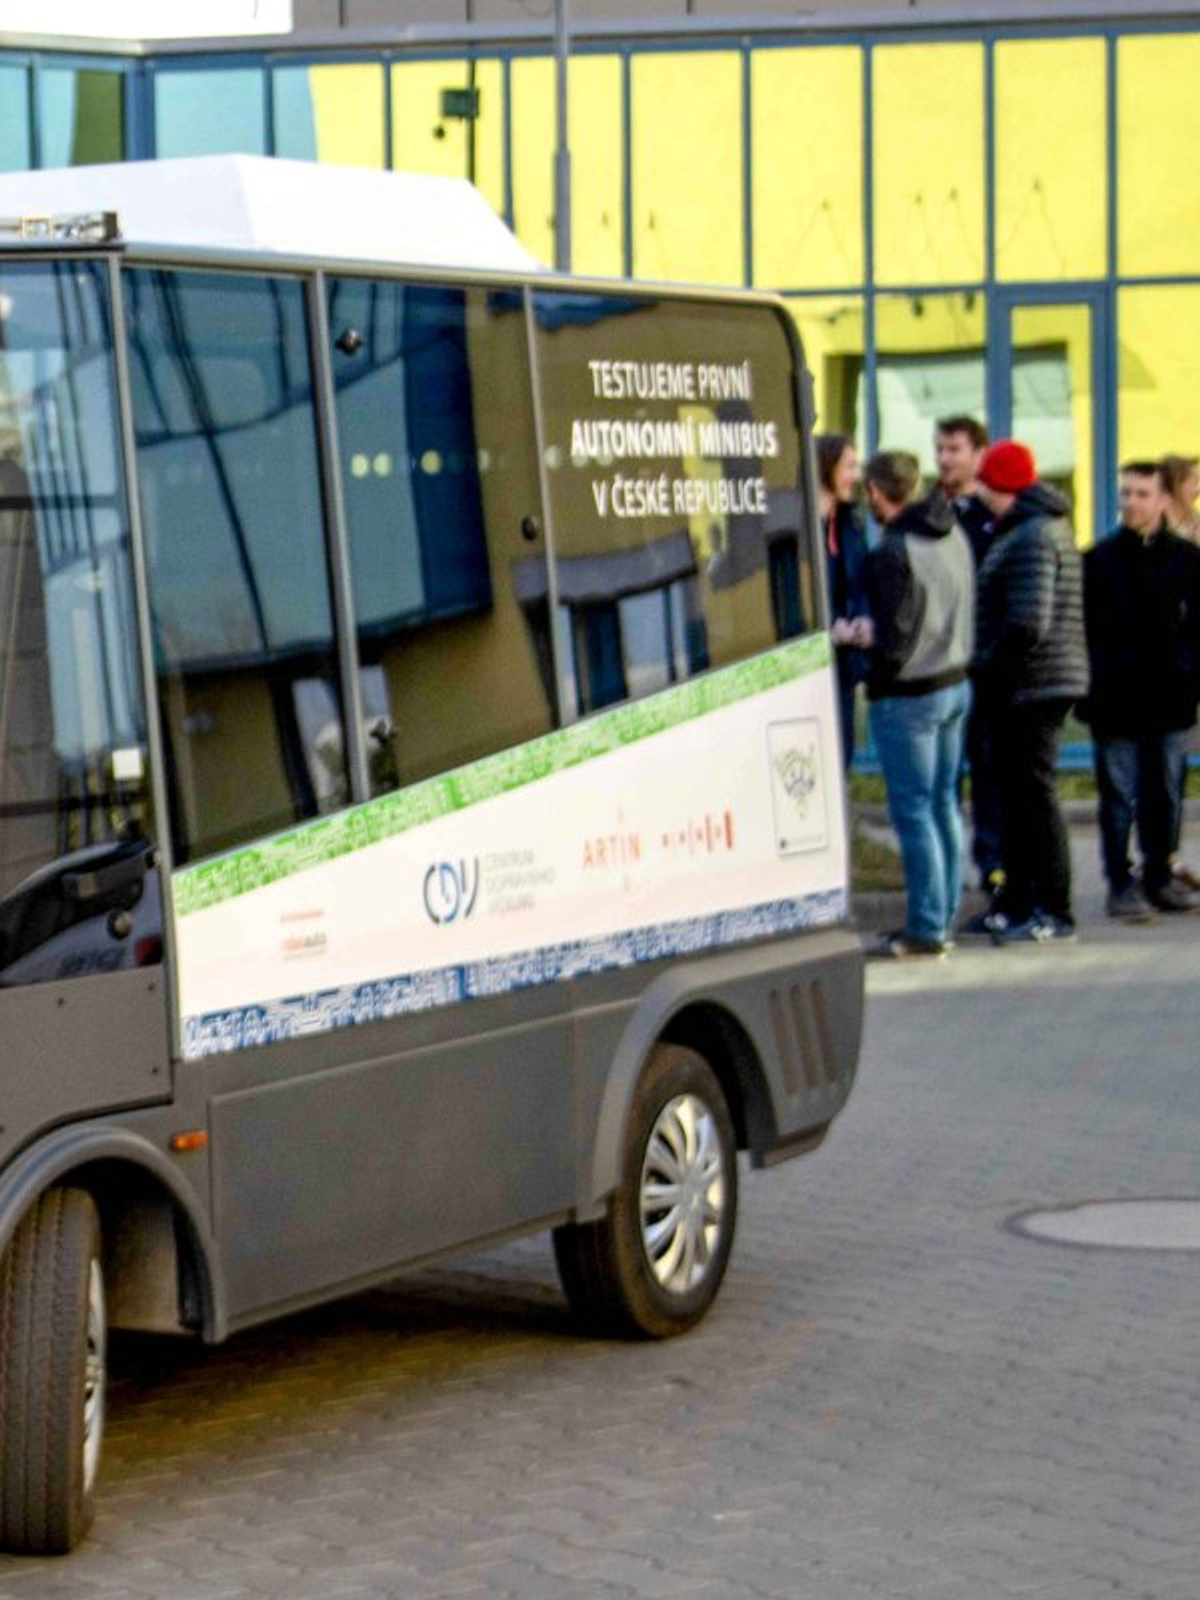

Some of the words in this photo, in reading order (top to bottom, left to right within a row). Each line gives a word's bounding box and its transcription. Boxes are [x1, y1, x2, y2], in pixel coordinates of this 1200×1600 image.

[588, 359, 696, 398] TESTUJEME
[698, 360, 752, 400] PRVNÍ
[571, 415, 696, 457] AUTONOMNÍ
[699, 421, 779, 458] MINIBUS
[592, 480, 606, 517] V
[612, 472, 670, 517] ČESKÉ
[673, 477, 769, 515] REPUBLICE
